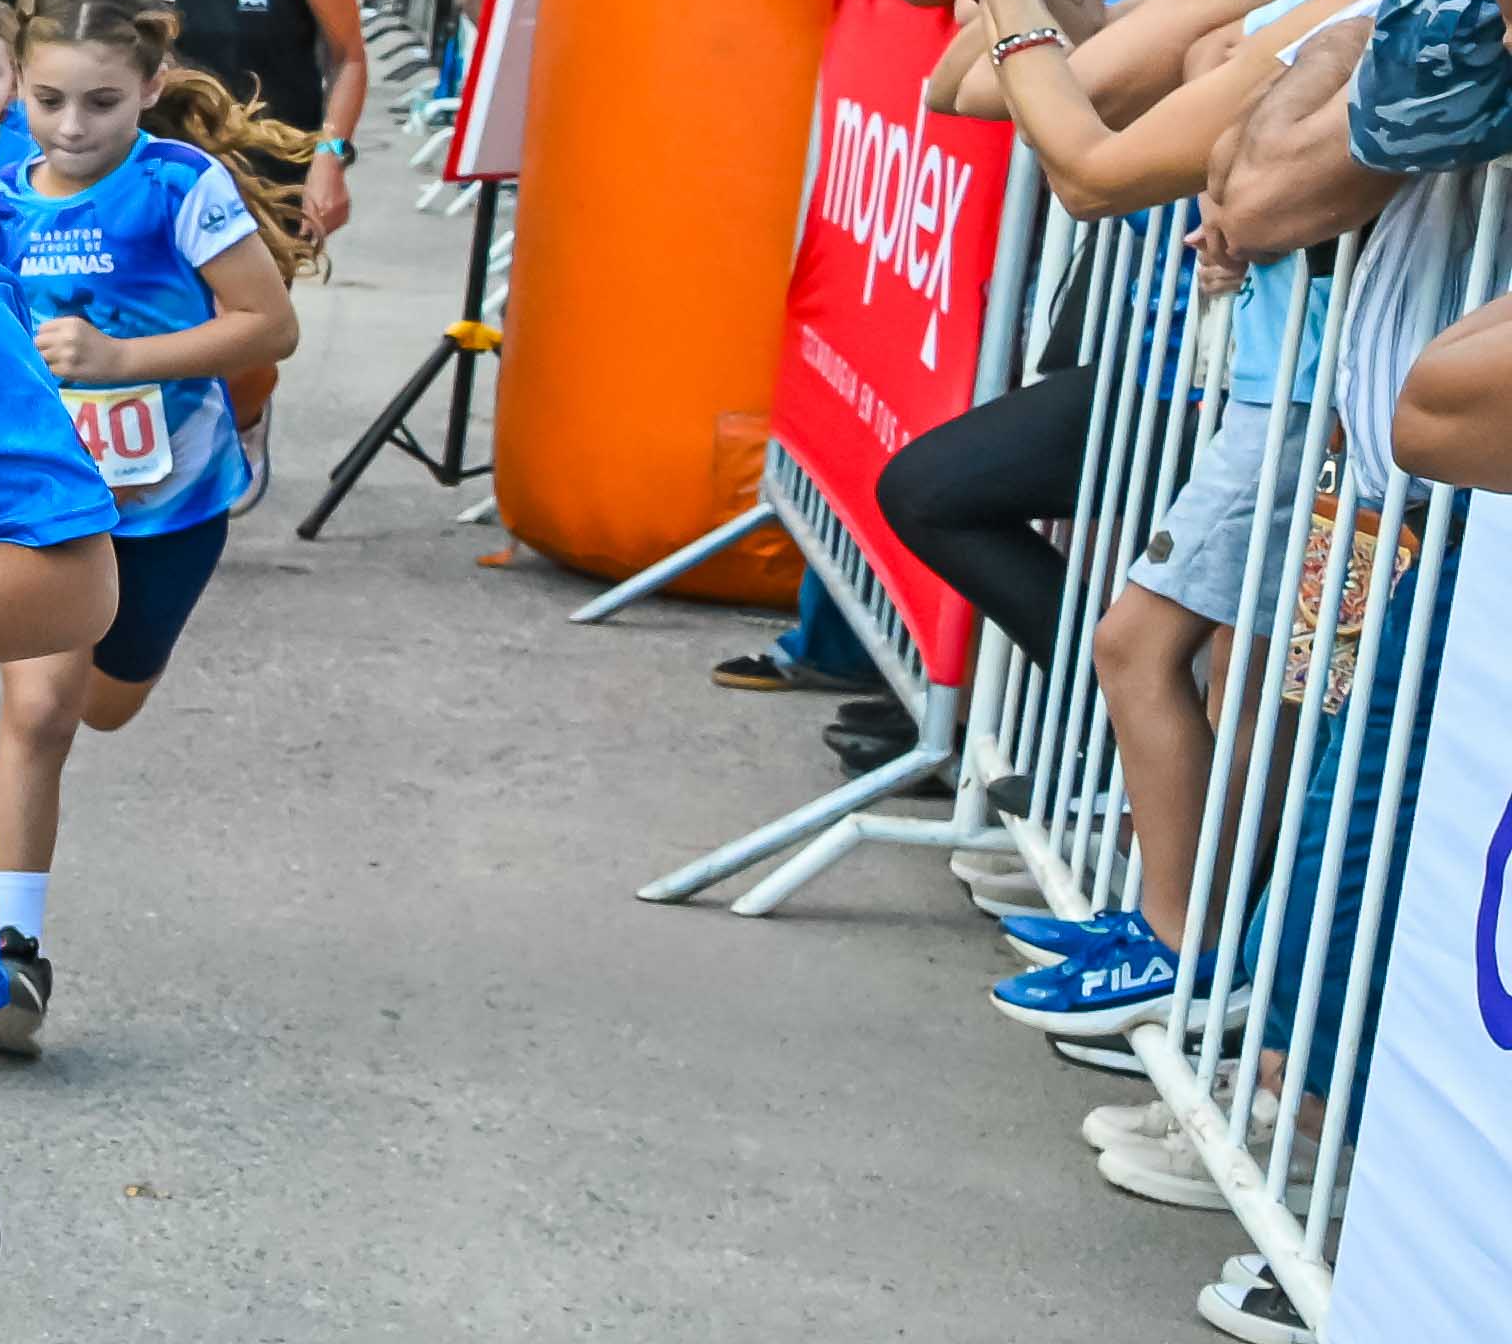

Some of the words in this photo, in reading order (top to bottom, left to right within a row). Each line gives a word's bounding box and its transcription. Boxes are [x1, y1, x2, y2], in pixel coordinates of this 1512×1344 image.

[822, 78, 972, 315] moplex
[20, 253, 114, 276] MALVINAS
[1081, 956, 1174, 997] FILA
